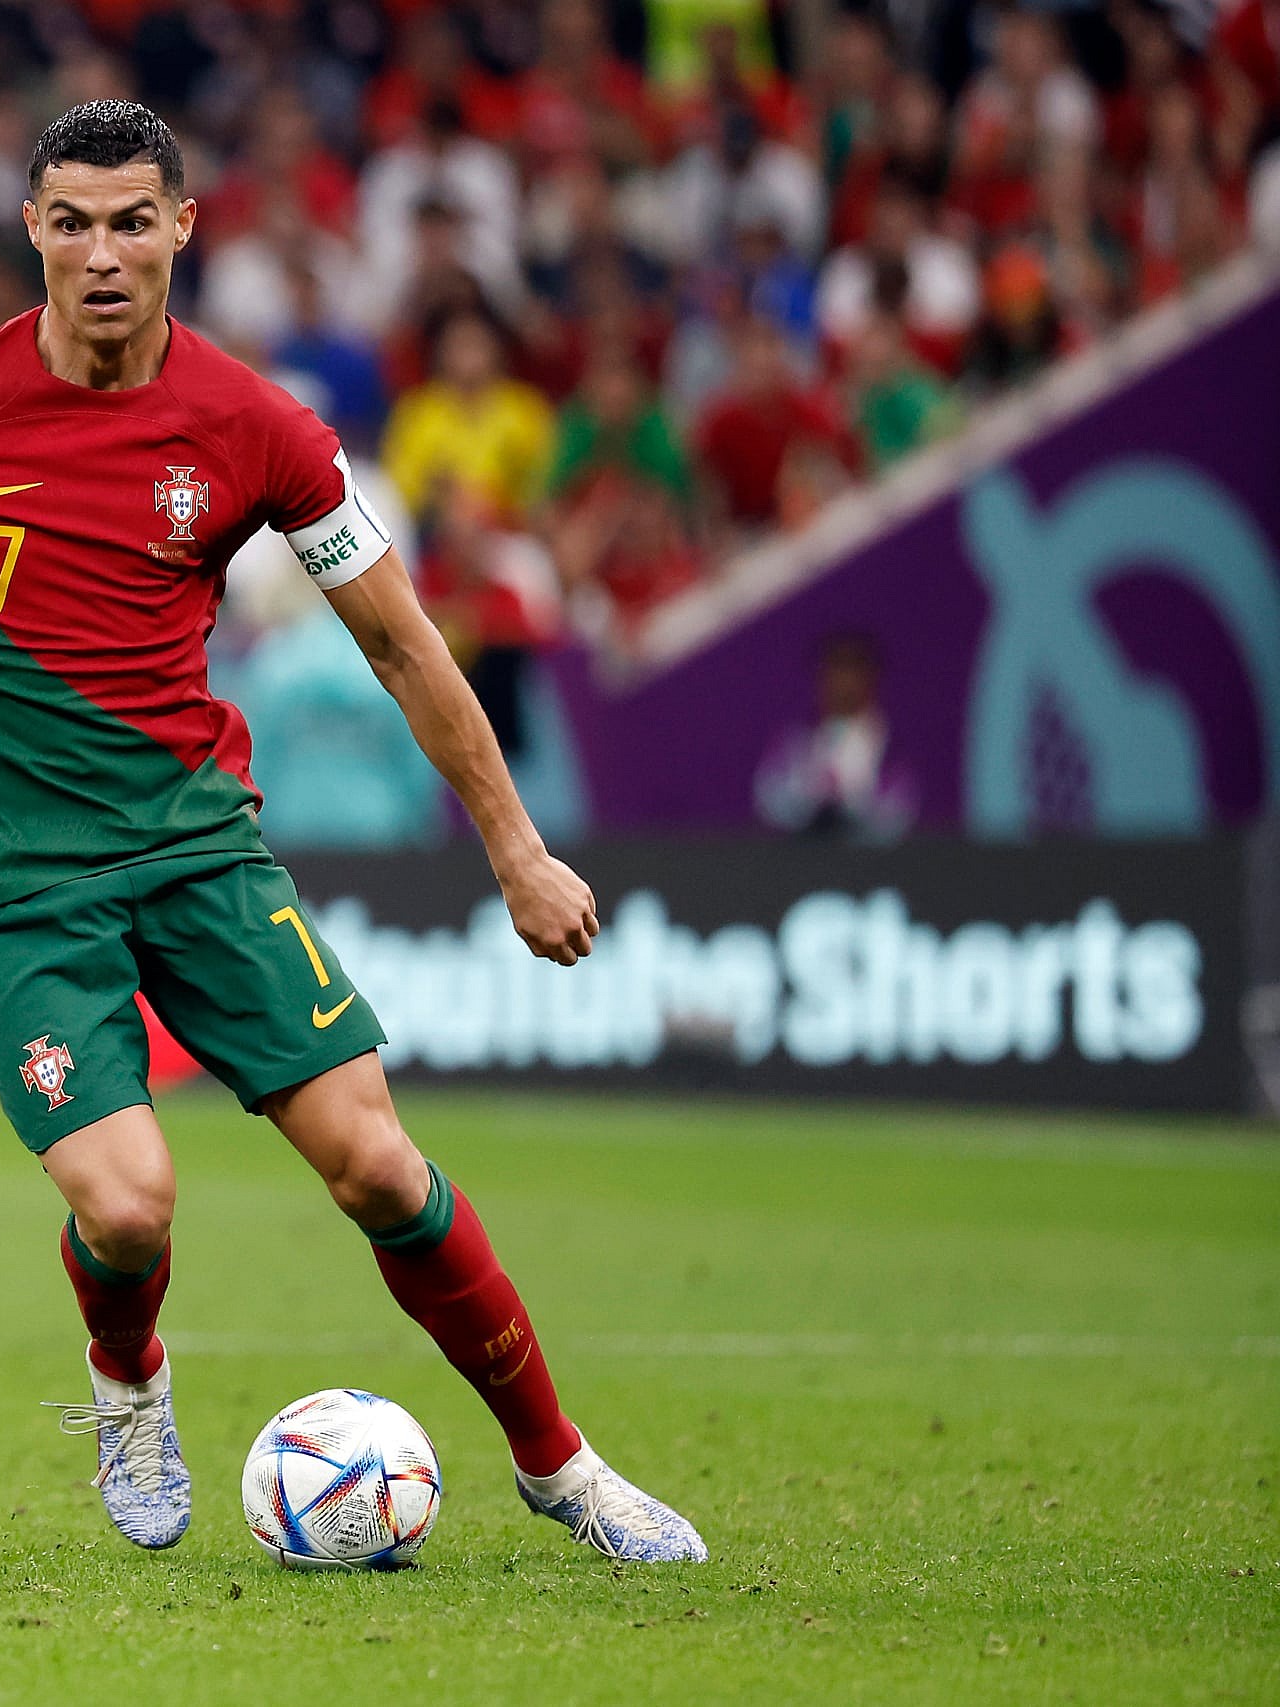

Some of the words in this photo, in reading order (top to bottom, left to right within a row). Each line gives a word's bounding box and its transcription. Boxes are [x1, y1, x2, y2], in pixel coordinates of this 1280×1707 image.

[296, 547, 319, 562] VE
[318, 524, 351, 553] THE
[305, 535, 359, 576] ANET
[269, 905, 331, 988] 7
[778, 887, 1205, 1068] Shorts
